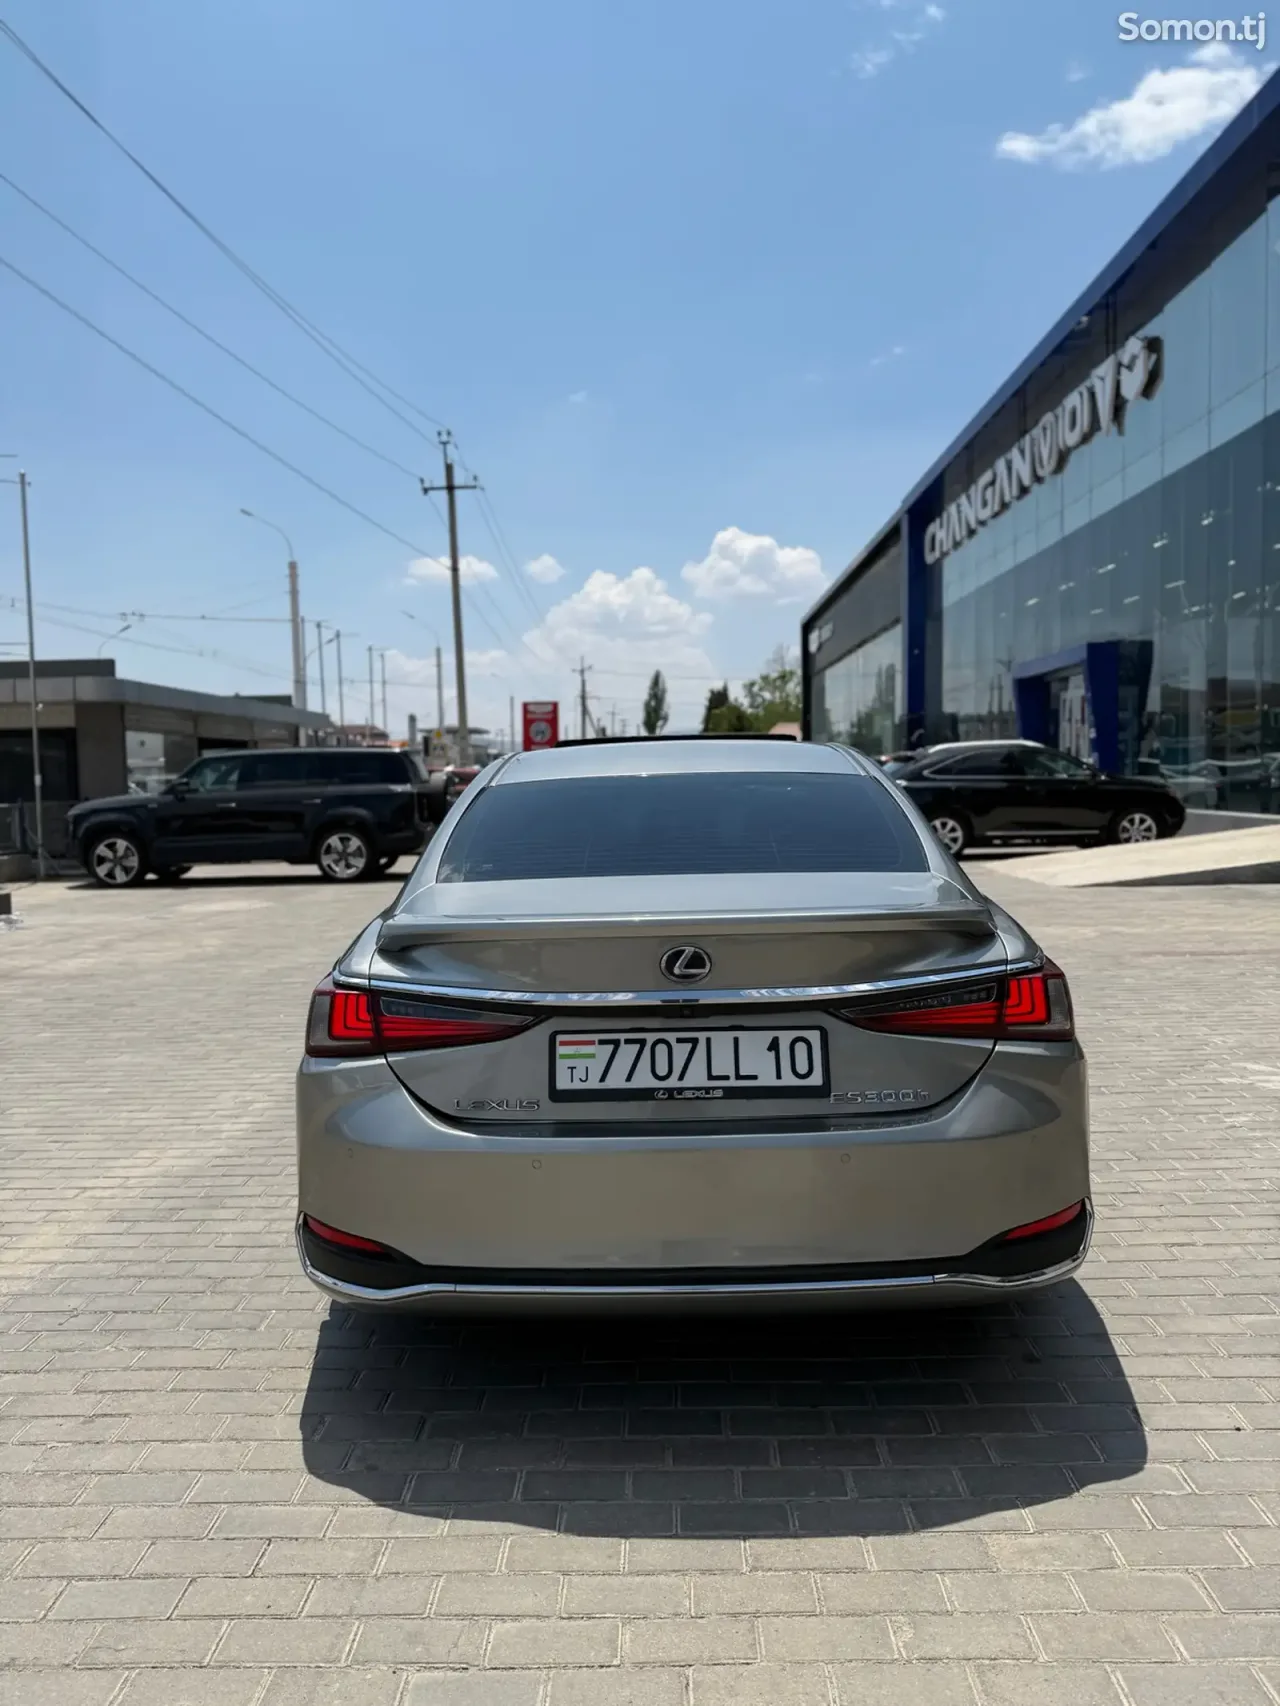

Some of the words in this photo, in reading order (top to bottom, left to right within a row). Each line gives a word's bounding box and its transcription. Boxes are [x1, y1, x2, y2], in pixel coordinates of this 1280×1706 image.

[924, 433, 1033, 565] CHANGAN
[567, 1065, 590, 1084] TJ
[673, 1089, 724, 1099] LEXUS
[453, 1099, 541, 1111] LEXUS
